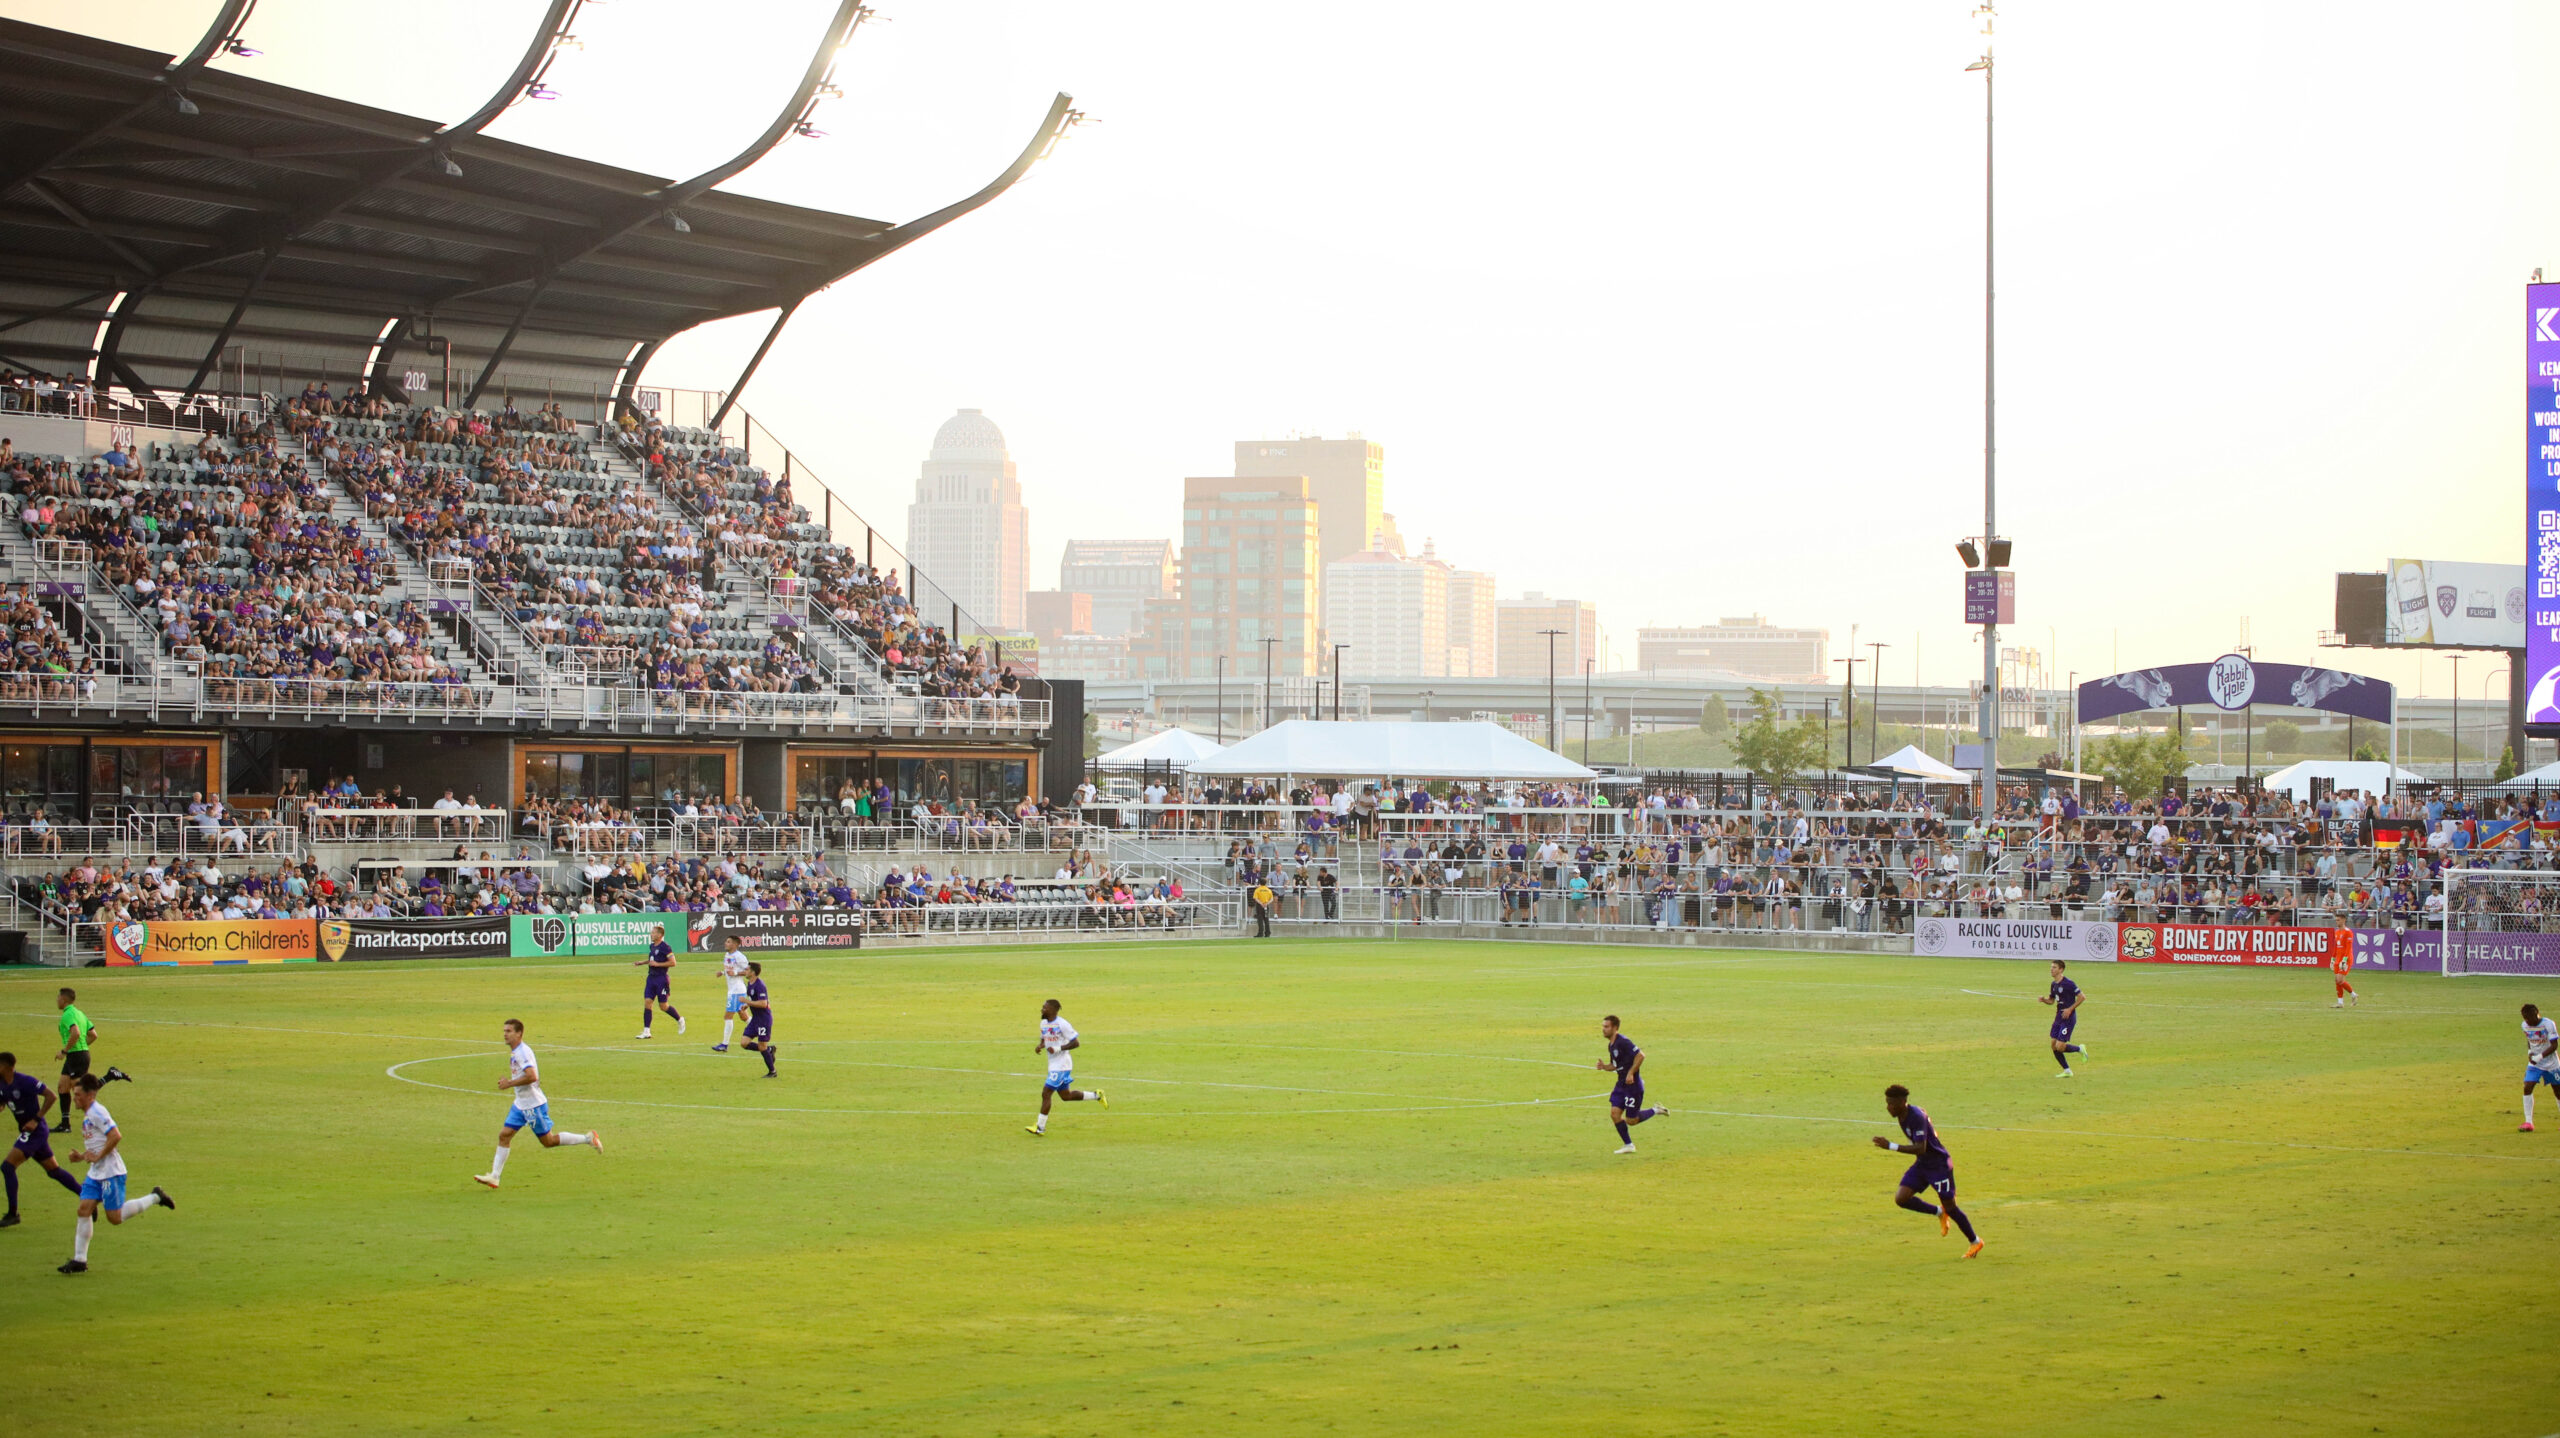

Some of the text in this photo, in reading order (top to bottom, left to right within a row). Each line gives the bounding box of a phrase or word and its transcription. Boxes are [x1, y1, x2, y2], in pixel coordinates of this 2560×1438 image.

[406, 371, 426, 390] 202
[641, 392, 658, 410] 201
[2534, 411, 2560, 426] WOR
[113, 426, 131, 447] 203
[37, 584, 83, 593] 204 203
[2215, 662, 2249, 692] Rabbit
[2223, 681, 2246, 707] Hole
[569, 922, 625, 934] LOUISVILLE
[722, 914, 785, 928] CLARK
[804, 913, 861, 927] RIGGS
[1959, 923, 2072, 940] RACING LOUISVILLE
[155, 929, 310, 951] Norton Children's
[326, 937, 346, 945] marka
[355, 930, 507, 951] markasports.com
[592, 934, 664, 946] CONSTRUCTI
[1972, 940, 2058, 951] FOOTBALL CLUB
[2163, 927, 2210, 950] BONE
[2252, 930, 2328, 952] ROOFING
[2173, 953, 2318, 965] BONEDRY.COM 502.425.2928
[2467, 944, 2535, 961] HEALTH
[758, 1027, 766, 1036] 12
[2061, 1027, 2068, 1035] 6
[1934, 1178, 1950, 1193] 77
